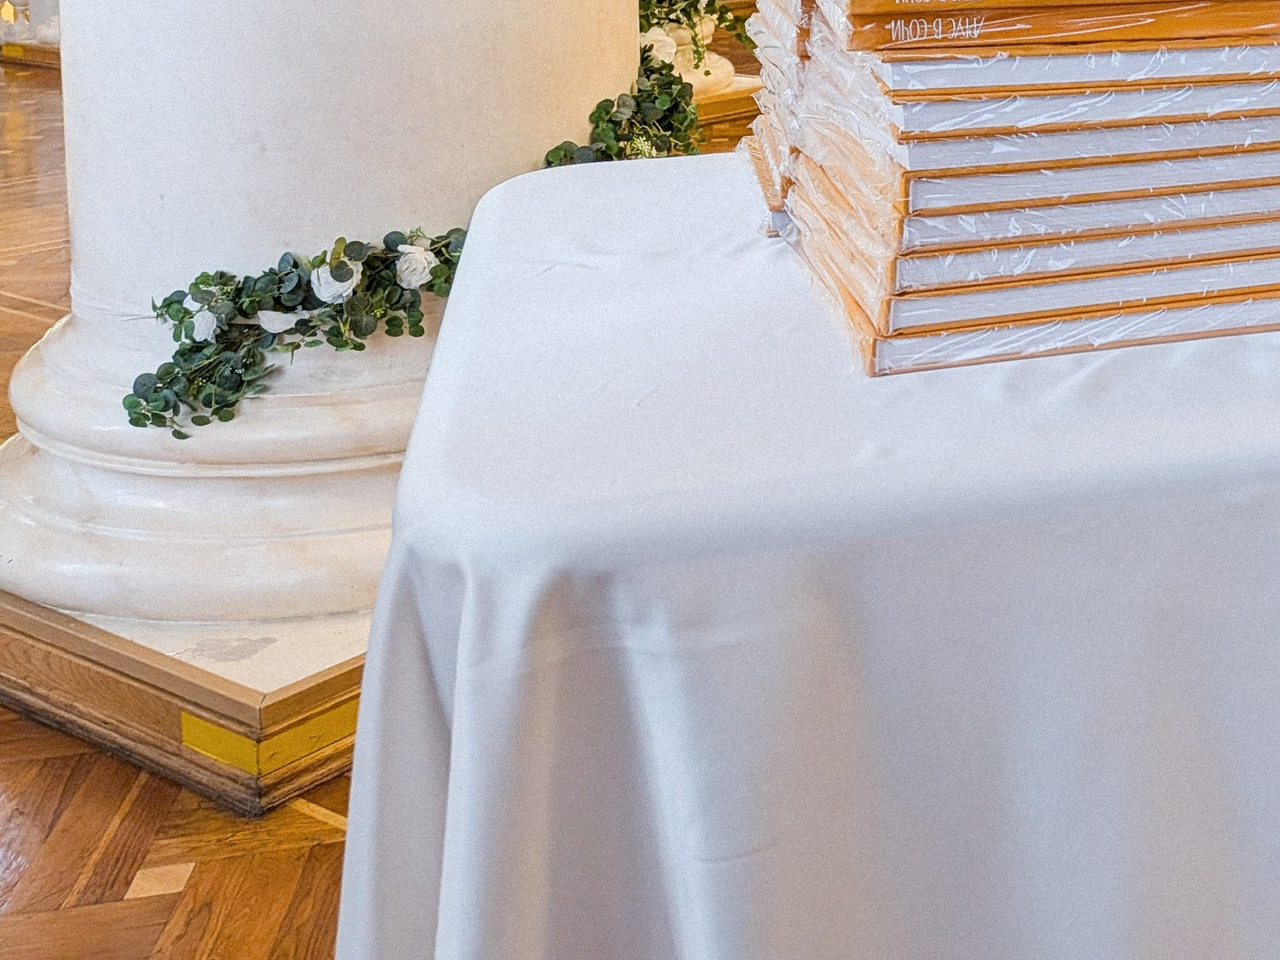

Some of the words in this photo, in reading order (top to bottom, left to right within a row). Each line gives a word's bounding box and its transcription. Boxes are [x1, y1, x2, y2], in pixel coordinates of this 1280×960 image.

[891, 19, 927, 41] СОЧИ
[933, 18, 942, 39] В
[947, 16, 985, 38] АРГУС
